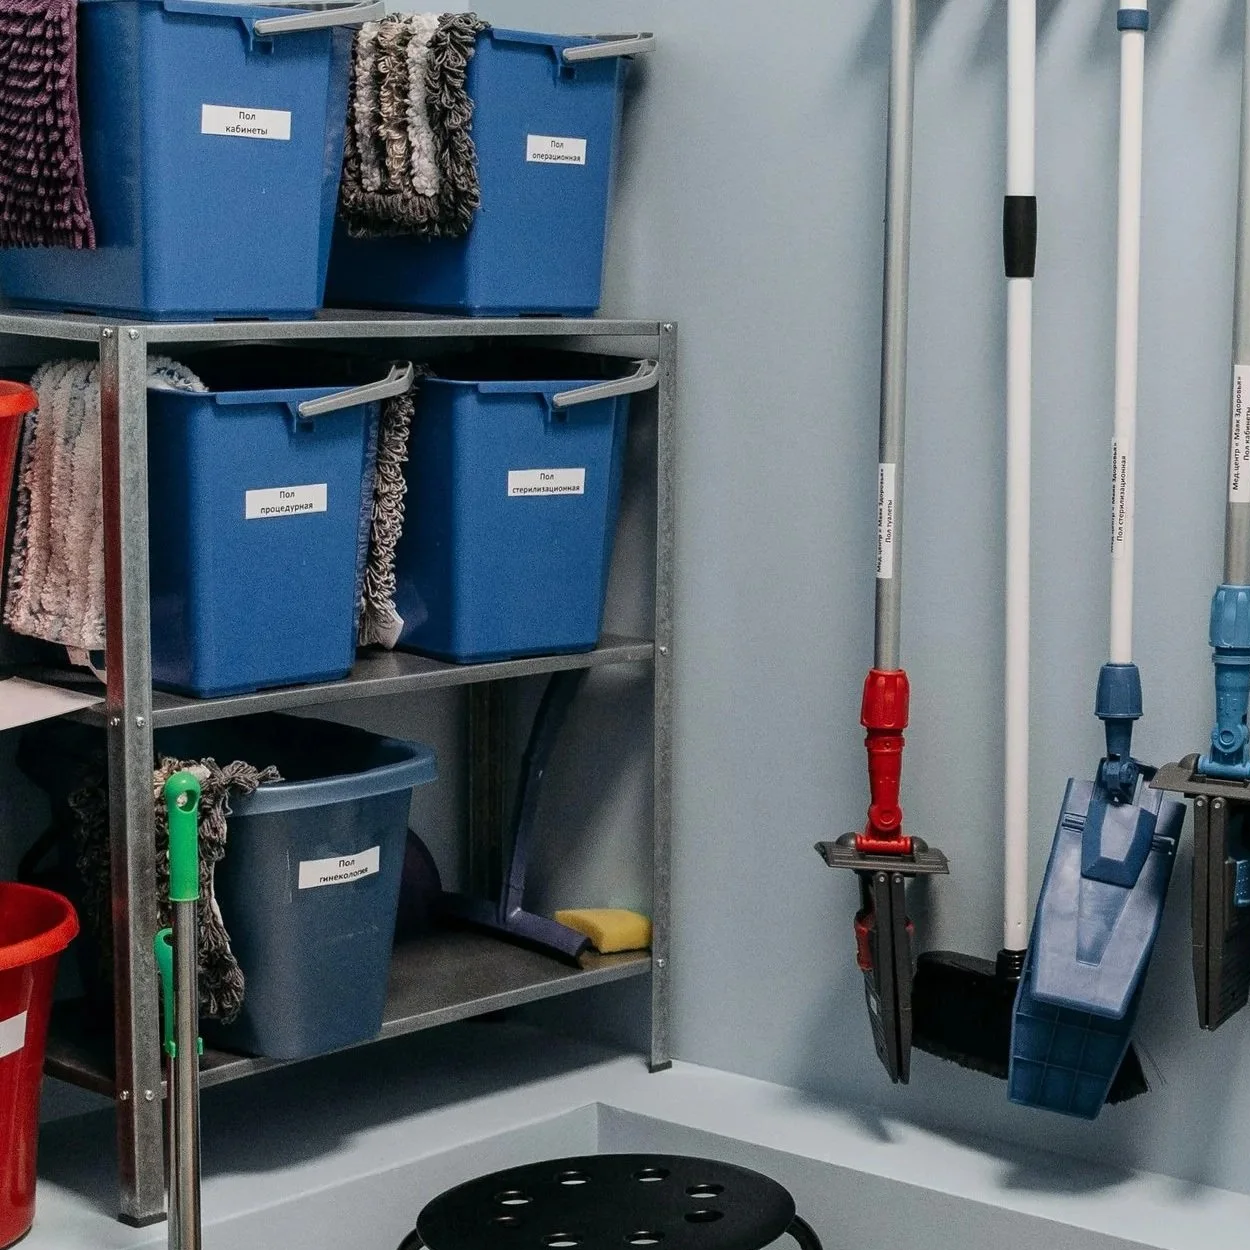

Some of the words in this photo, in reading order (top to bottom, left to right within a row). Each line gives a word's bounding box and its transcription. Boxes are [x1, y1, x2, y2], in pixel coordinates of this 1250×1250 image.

[239, 111, 256, 121] Пол
[225, 125, 268, 136] кабинеты
[550, 140, 564, 150] Пол
[532, 153, 582, 163] операционная
[540, 473, 554, 481] Пол
[512, 485, 580, 494] стерилизационная
[1118, 456, 1126, 525] стерилизационная
[279, 491, 295, 499] Пол
[260, 502, 313, 515] процедурная
[338, 859, 355, 868] Пол
[319, 867, 368, 883] гинекология
